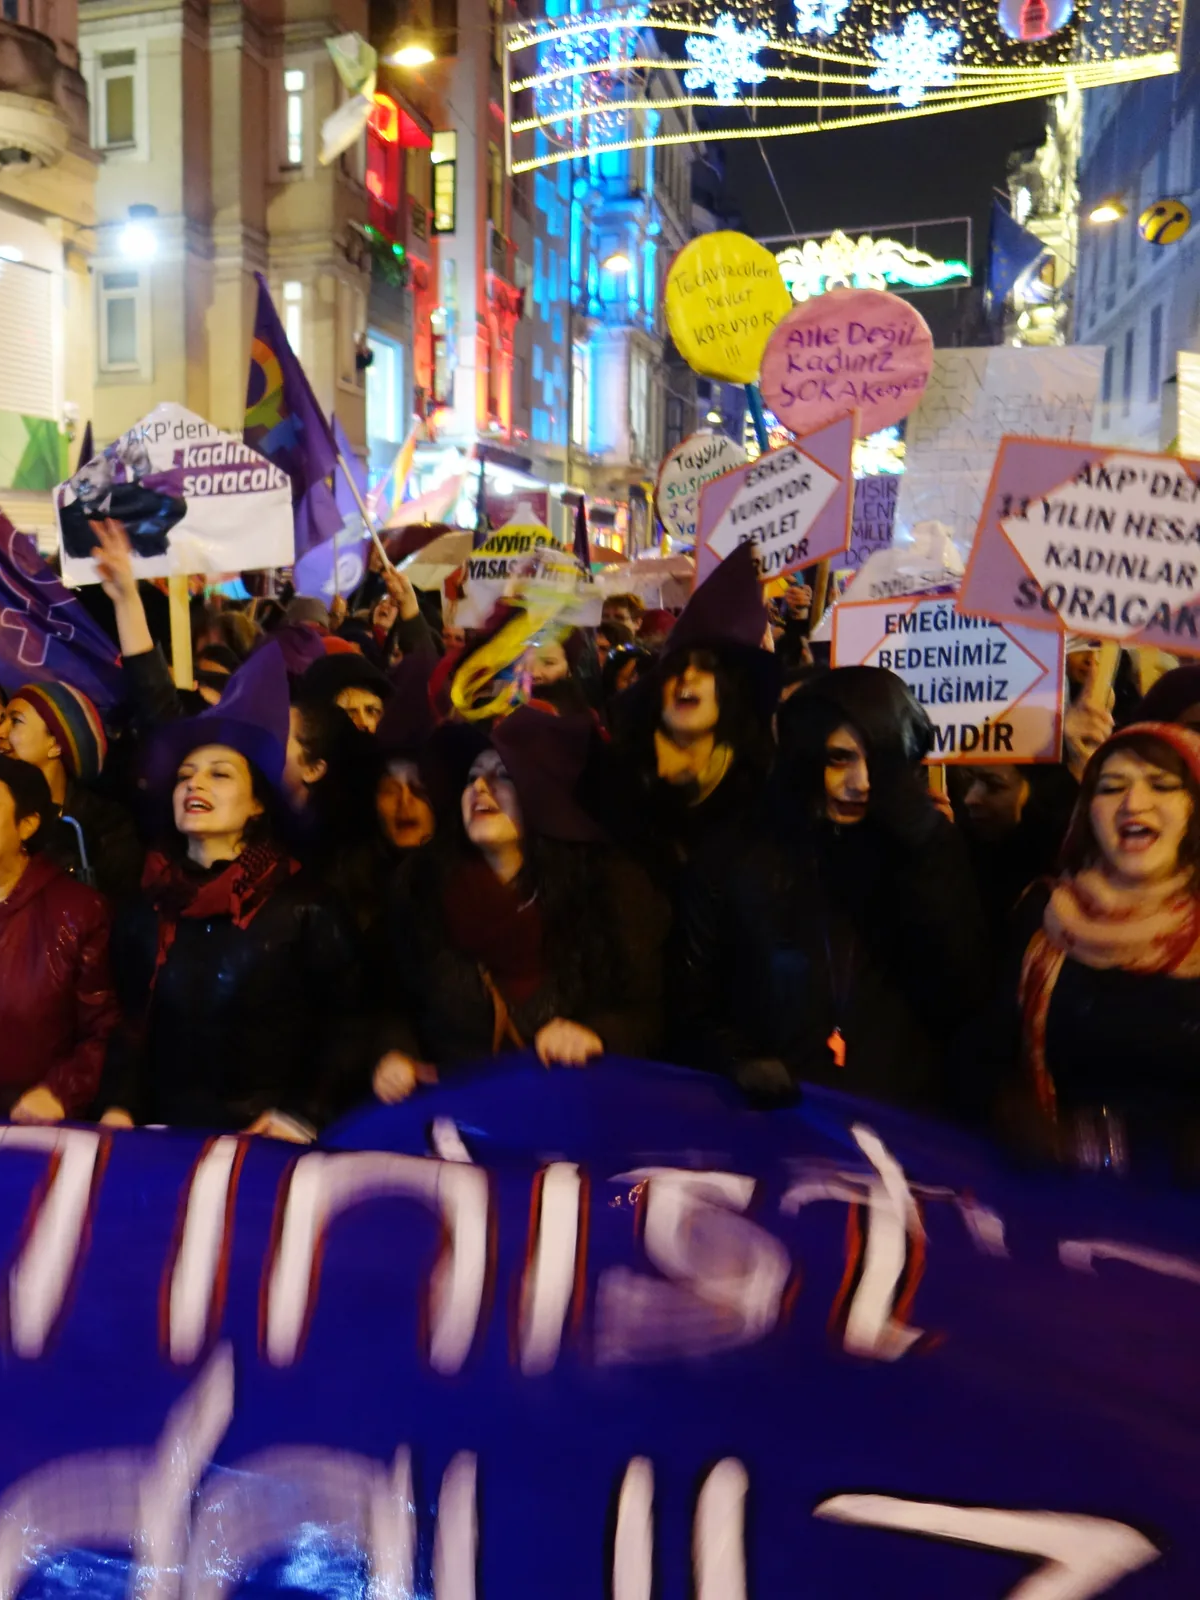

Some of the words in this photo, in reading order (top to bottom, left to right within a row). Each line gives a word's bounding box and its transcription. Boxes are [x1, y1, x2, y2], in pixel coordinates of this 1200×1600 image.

[693, 310, 779, 346] KORUYOR
[127, 419, 210, 446] AKP'den
[183, 441, 266, 469] kadın
[672, 436, 729, 473] Tayyip
[744, 450, 803, 488] ERKEK
[730, 474, 812, 525] VURUYOR
[1040, 496, 1116, 534] YILIN
[1122, 511, 1200, 548] HESA
[752, 538, 810, 576] RUYOR
[1044, 542, 1199, 590] KADINLAR
[878, 638, 1007, 669] BEDENİMİZ
[908, 675, 1009, 706] LİĞİMİZ
[930, 716, 1014, 753] MDİR
